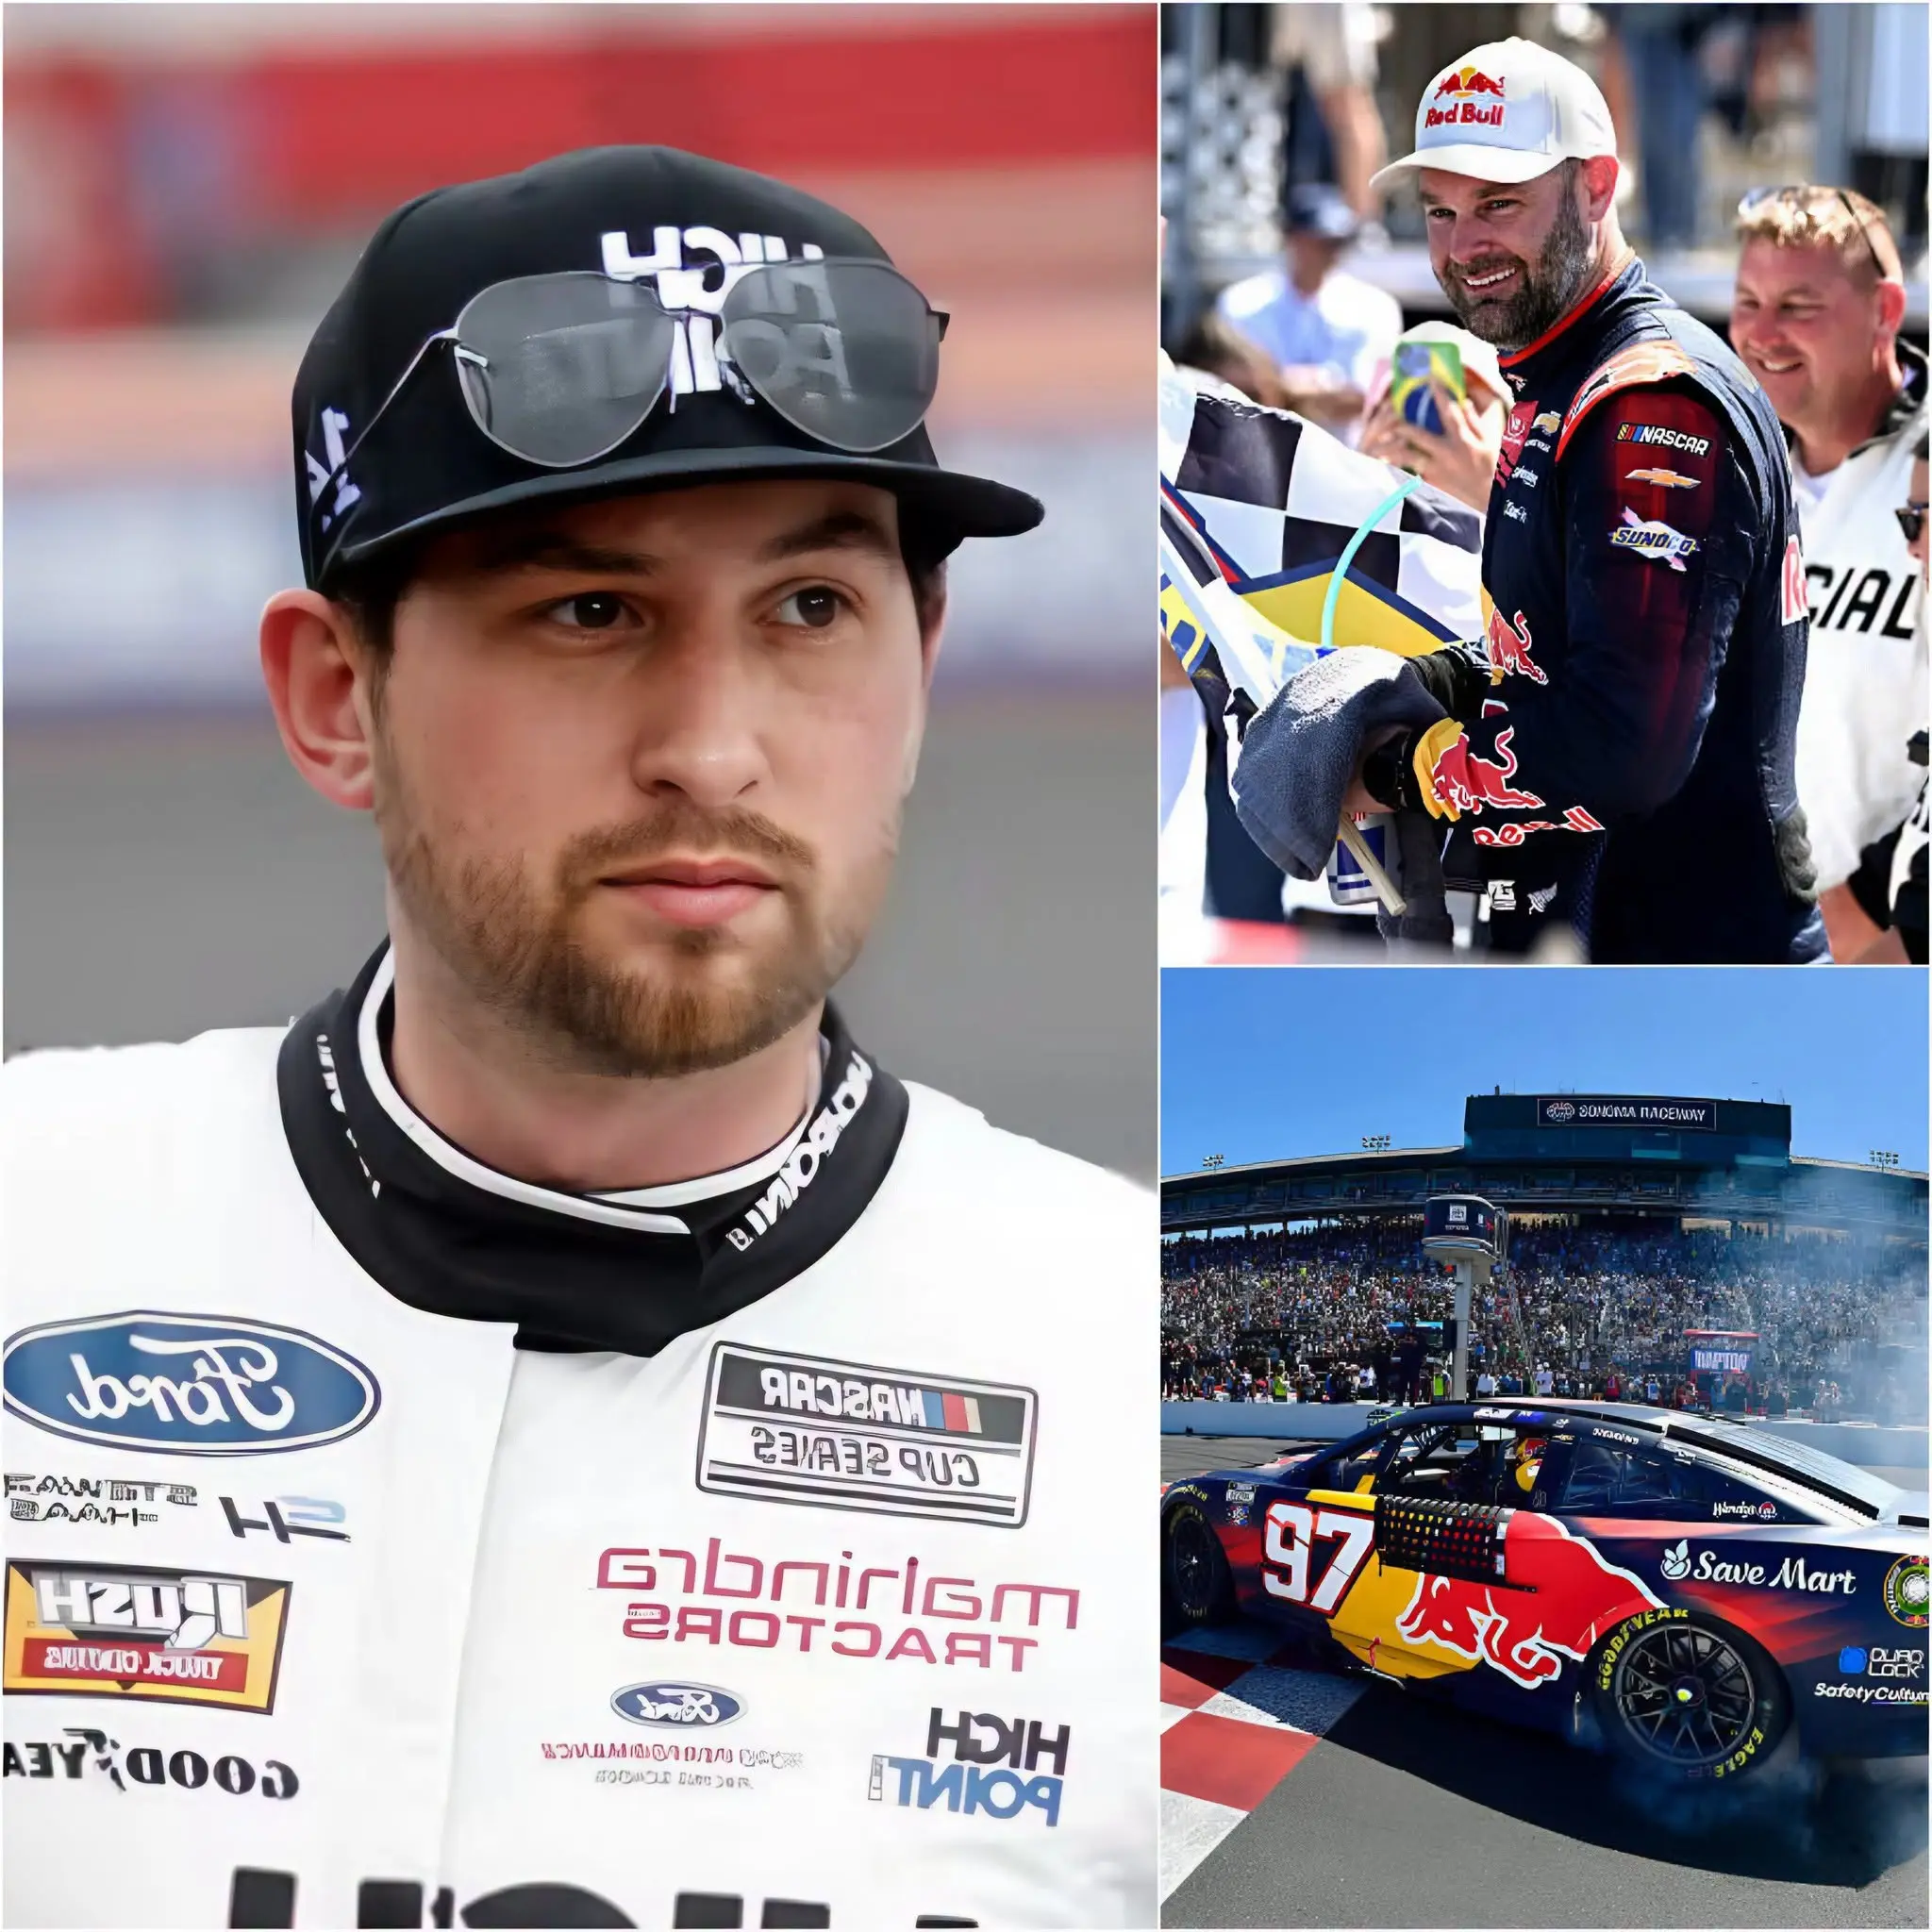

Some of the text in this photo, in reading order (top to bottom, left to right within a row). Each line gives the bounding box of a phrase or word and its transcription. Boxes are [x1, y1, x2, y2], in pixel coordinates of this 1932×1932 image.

[1424, 102, 1506, 129] Red Bull
[1639, 425, 1710, 457] NASCAR
[1615, 526, 1695, 556] SUNOCO
[1262, 1500, 1375, 1616] 97
[1693, 1550, 1857, 1595] Save Mart
